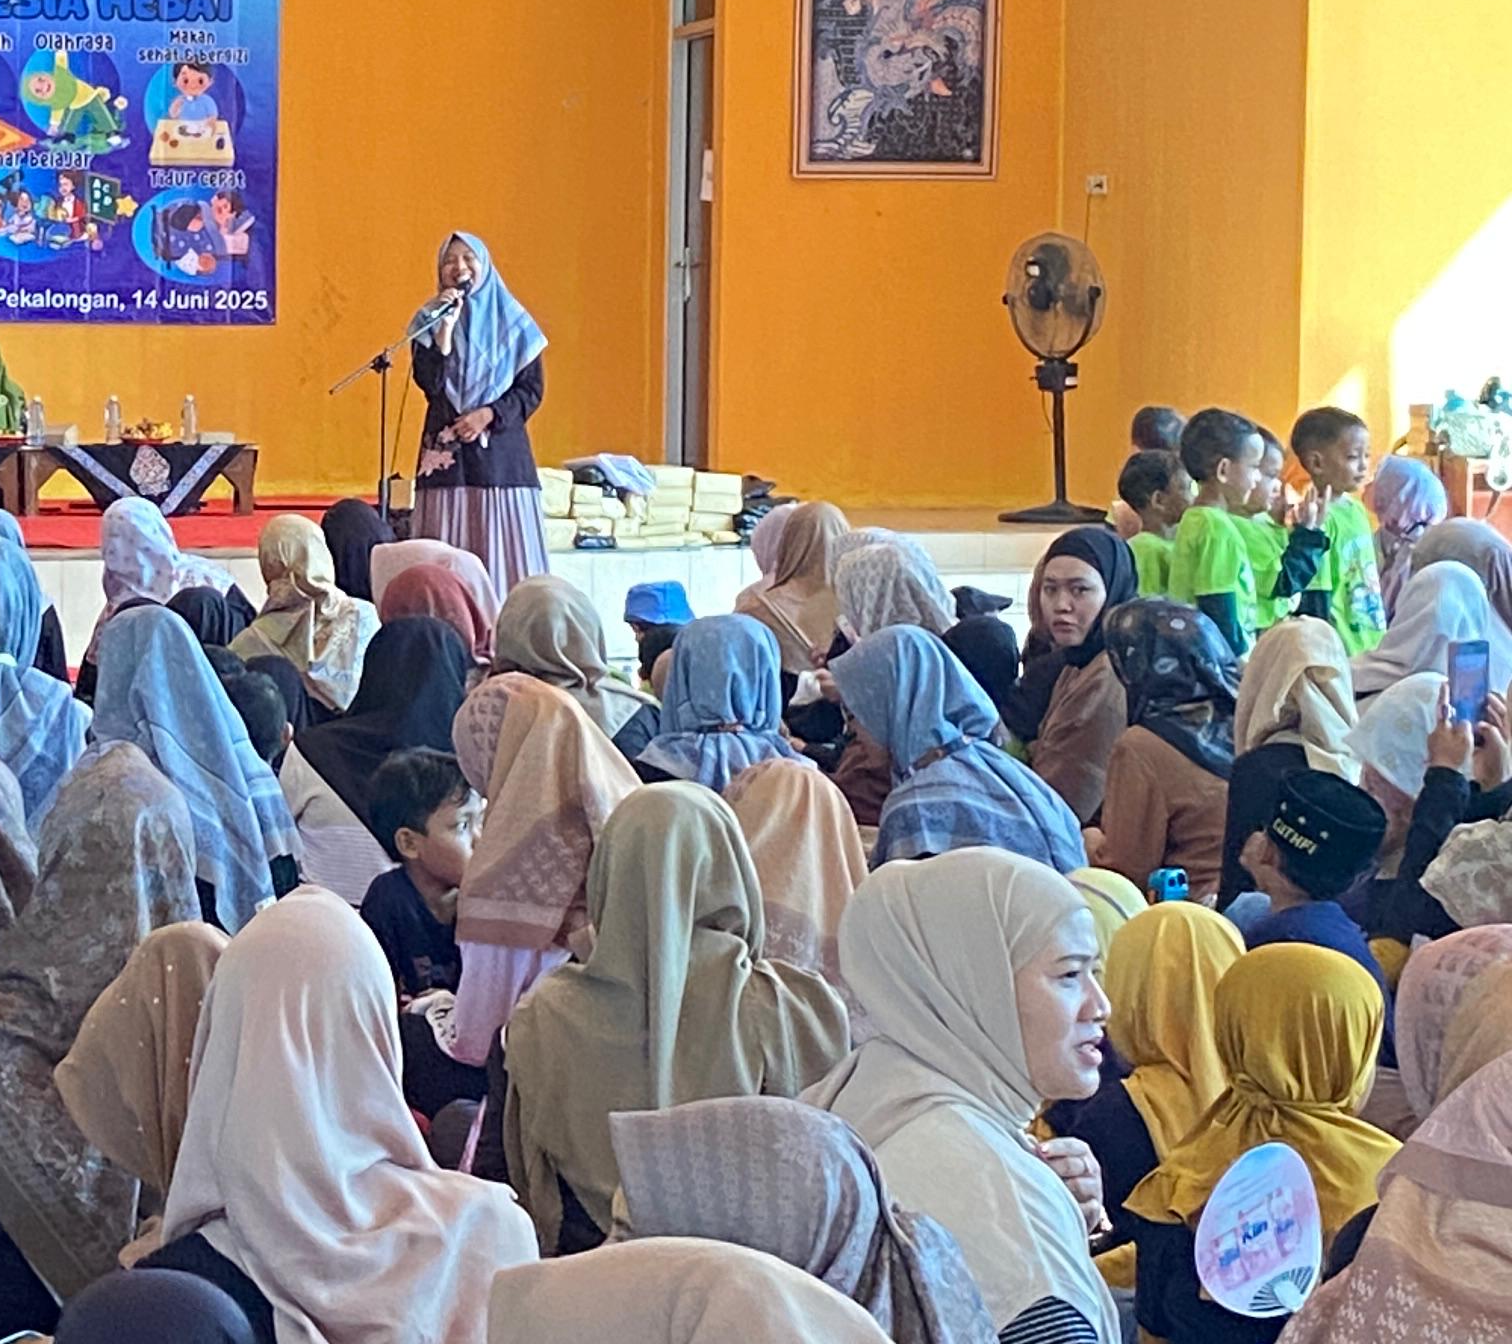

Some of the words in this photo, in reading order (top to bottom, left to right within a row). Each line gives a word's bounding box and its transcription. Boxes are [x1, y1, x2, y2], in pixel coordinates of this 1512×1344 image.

[35, 33, 115, 51] Olahraga
[169, 29, 216, 45] Makan
[132, 290, 157, 309] 14
[162, 290, 209, 309] Juni
[215, 291, 268, 309] 2025
